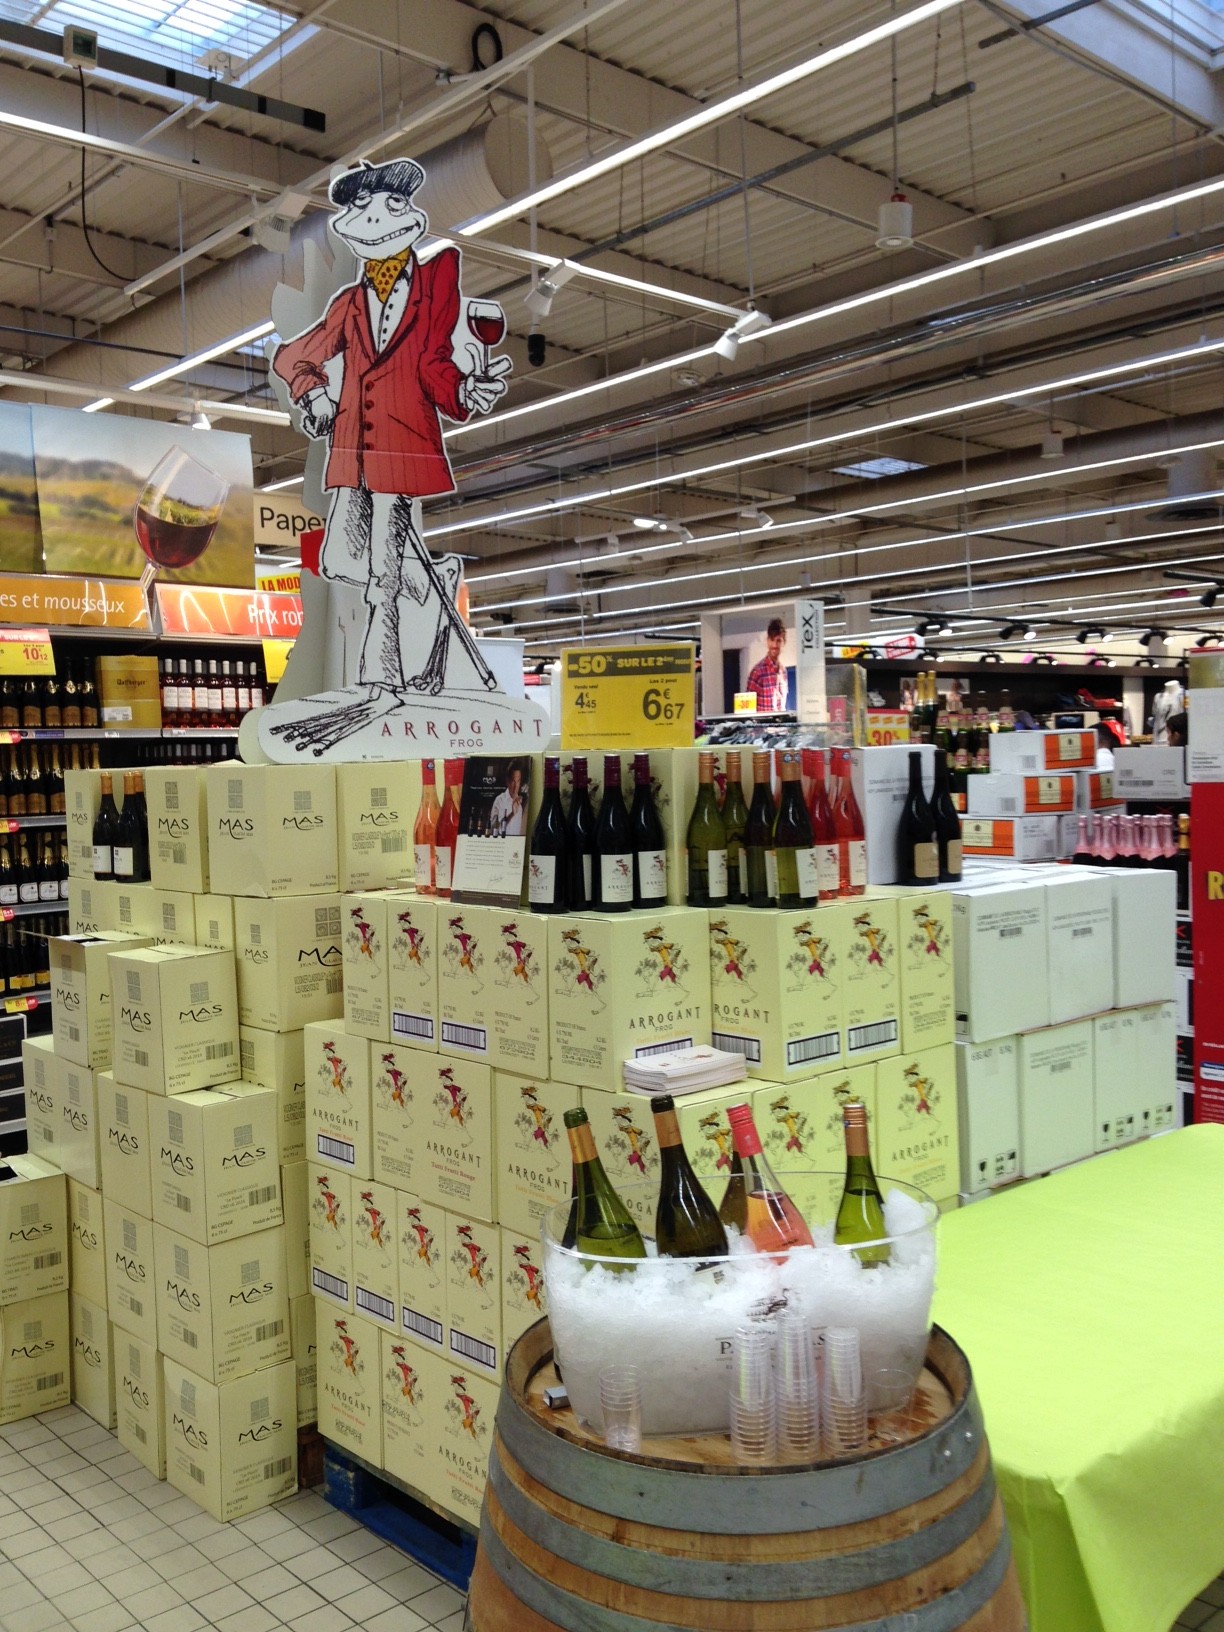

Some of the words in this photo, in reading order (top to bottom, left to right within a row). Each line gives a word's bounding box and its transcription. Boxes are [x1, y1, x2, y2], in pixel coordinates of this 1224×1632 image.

[0, 594, 17, 607] es
[22, 593, 40, 609] et
[44, 597, 125, 613] mousseux
[617, 657, 639, 668] SUR
[641, 657, 654, 667] LE
[381, 718, 543, 740] ARROGANT
[450, 739, 484, 748] FROG
[71, 812, 88, 825] MAS
[158, 818, 189, 838] MAS
[219, 818, 254, 840] MAS
[282, 815, 324, 830] MAS
[360, 811, 399, 827] MAS
[76, 921, 99, 934] MAS
[244, 948, 269, 965] MAS
[298, 945, 343, 967] MA
[56, 988, 80, 1011] MAS
[121, 1006, 152, 1032] MAS
[179, 1004, 223, 1022] MAS
[629, 1006, 701, 1030] ARROGANT
[714, 1003, 770, 1024] ROGANT
[721, 1016, 740, 1025] FROG
[655, 1023, 673, 1032] FROG
[30, 1089, 53, 1113] MAS
[63, 1106, 88, 1131] MAS
[312, 1107, 359, 1132] ARROGANT
[108, 1128, 139, 1155] MAS
[892, 1135, 950, 1162] ARROGANT
[161, 1147, 194, 1176] MAS
[222, 1147, 266, 1168] MAS
[426, 1140, 481, 1169] ARROGANT
[508, 1163, 568, 1195] ARROGANT
[530, 1182, 545, 1193] FROG
[9, 1223, 53, 1241] MAS
[72, 1222, 97, 1250] MAS
[115, 1252, 146, 1283] MAS
[166, 1280, 200, 1312] MAS
[229, 1282, 274, 1304] MAS
[11, 1340, 55, 1358] MAS
[75, 1337, 101, 1367] MAS
[123, 1376, 149, 1410] MAS
[324, 1383, 371, 1418] ARROGANT
[173, 1413, 208, 1449] MAS
[238, 1419, 283, 1442] MAS
[438, 1445, 487, 1480] ARROGAN
